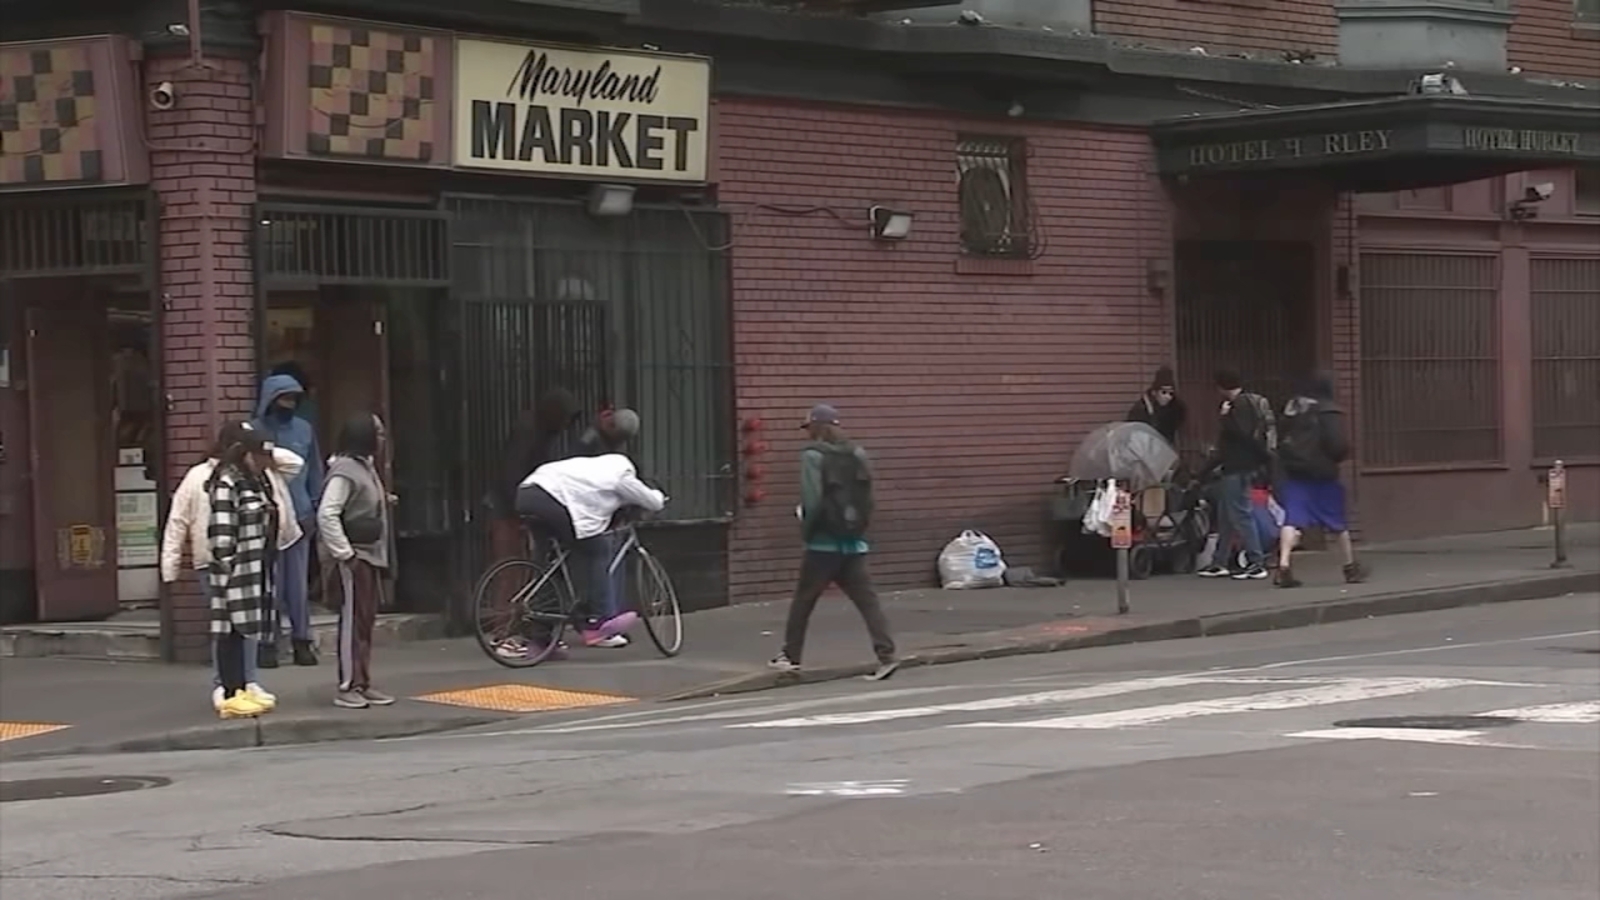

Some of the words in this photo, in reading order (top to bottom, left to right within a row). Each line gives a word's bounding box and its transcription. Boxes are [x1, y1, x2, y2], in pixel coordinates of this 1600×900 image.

[506, 49, 661, 106] Maryland
[471, 99, 698, 171] MARKET
[1189, 139, 1275, 166] HOTEL
[1465, 128, 1518, 150] HOTEL
